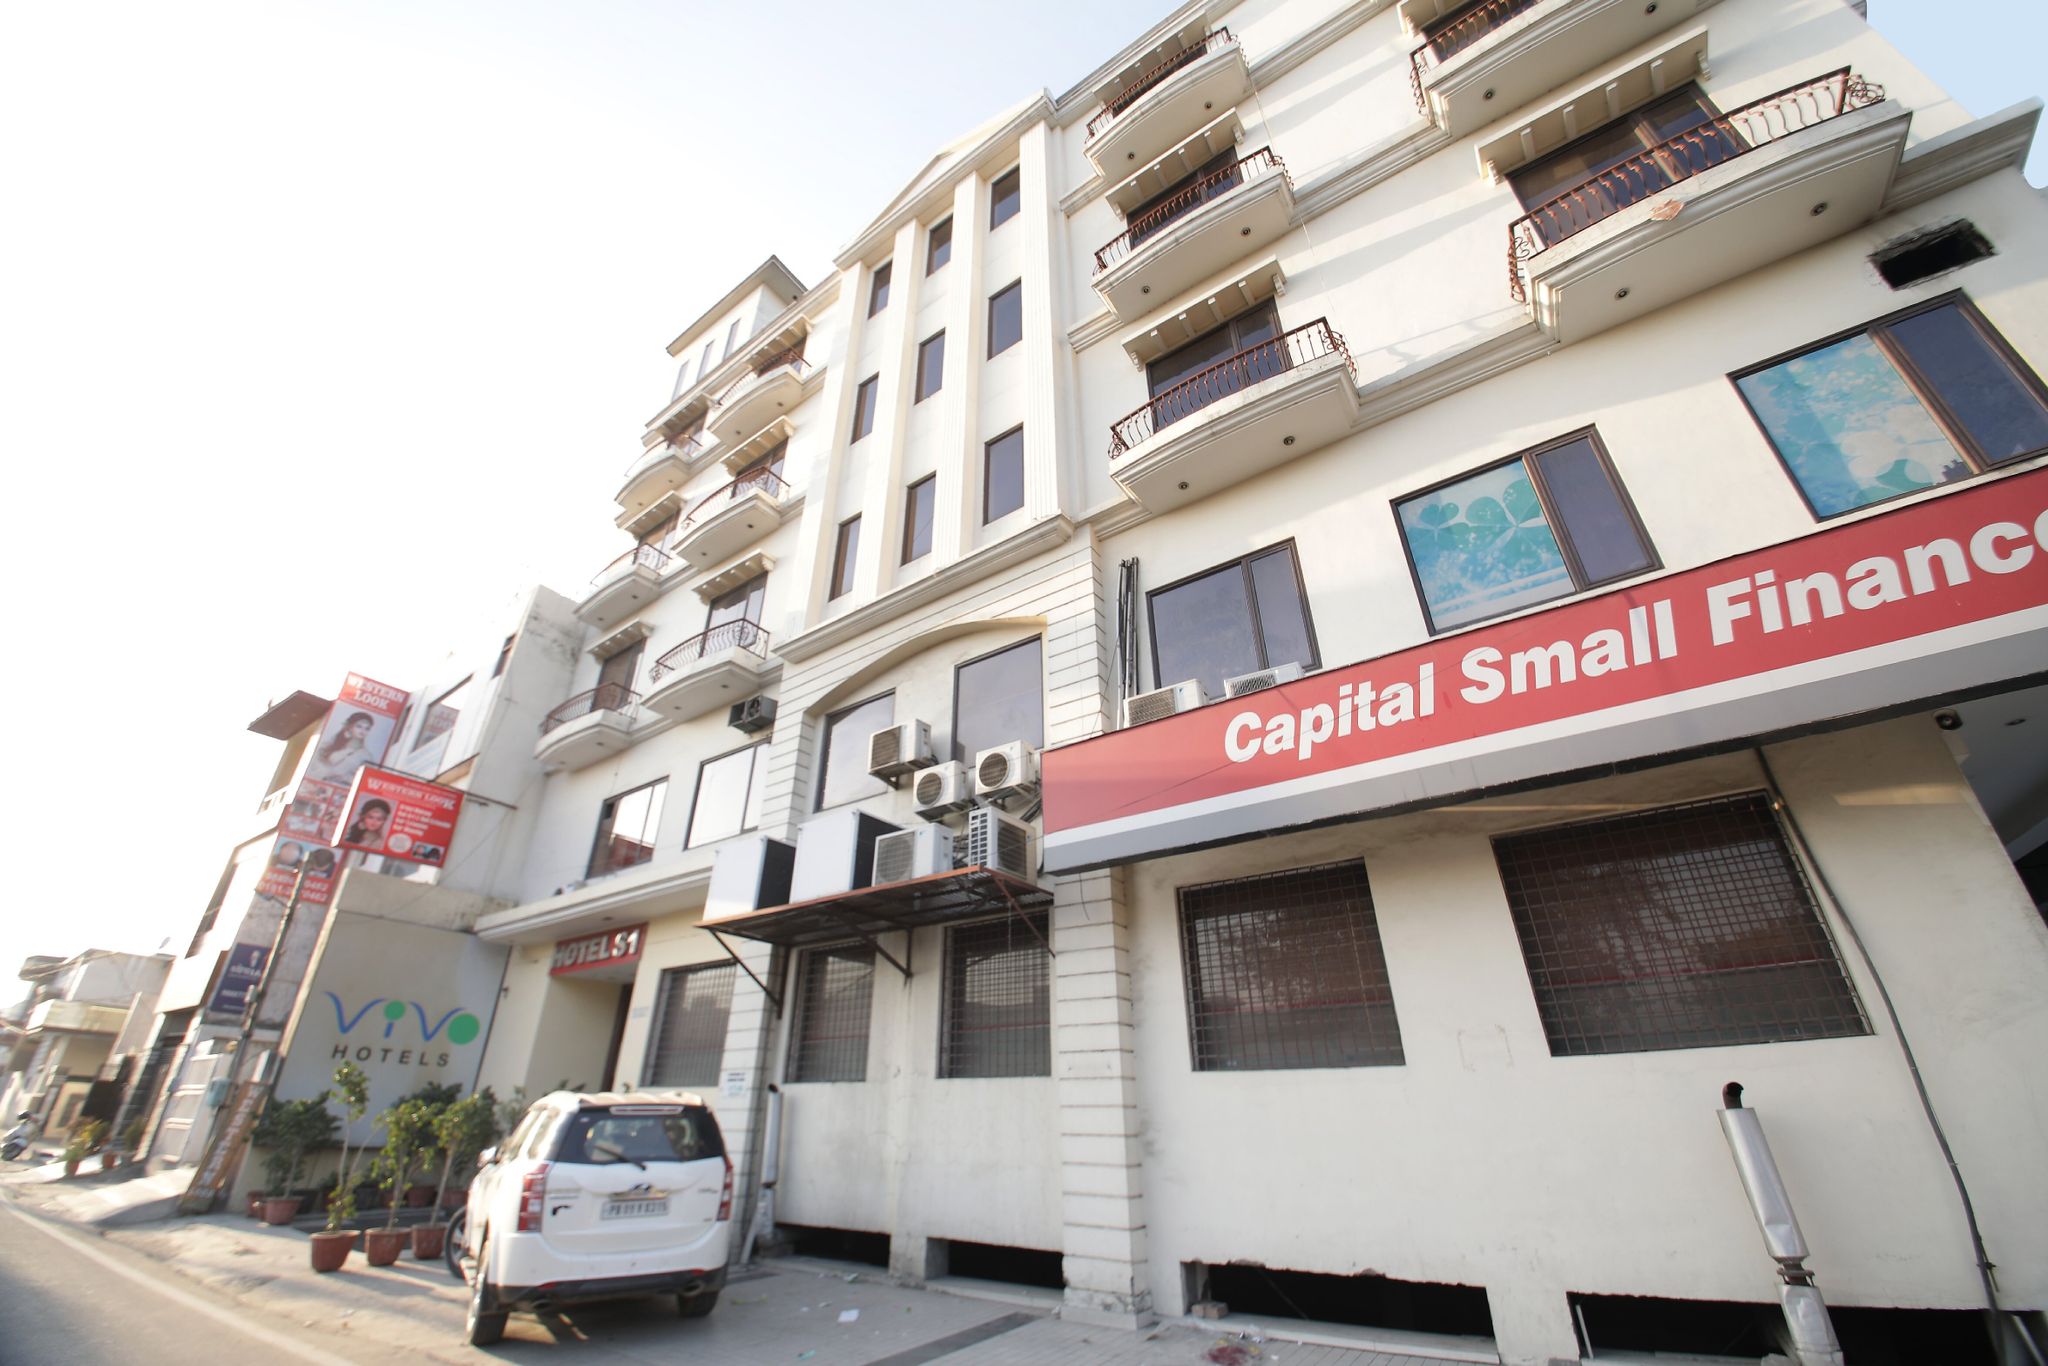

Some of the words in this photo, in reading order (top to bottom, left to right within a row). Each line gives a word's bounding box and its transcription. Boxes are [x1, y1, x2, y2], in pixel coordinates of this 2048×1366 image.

[1224, 661, 1435, 763] Capital
[1460, 598, 1678, 706] Small
[1706, 507, 2048, 647] Financ
[353, 690, 390, 710] LOOK
[552, 935, 610, 968] HOTEL
[612, 928, 640, 957] S1
[331, 1044, 450, 1068] HOTELS
